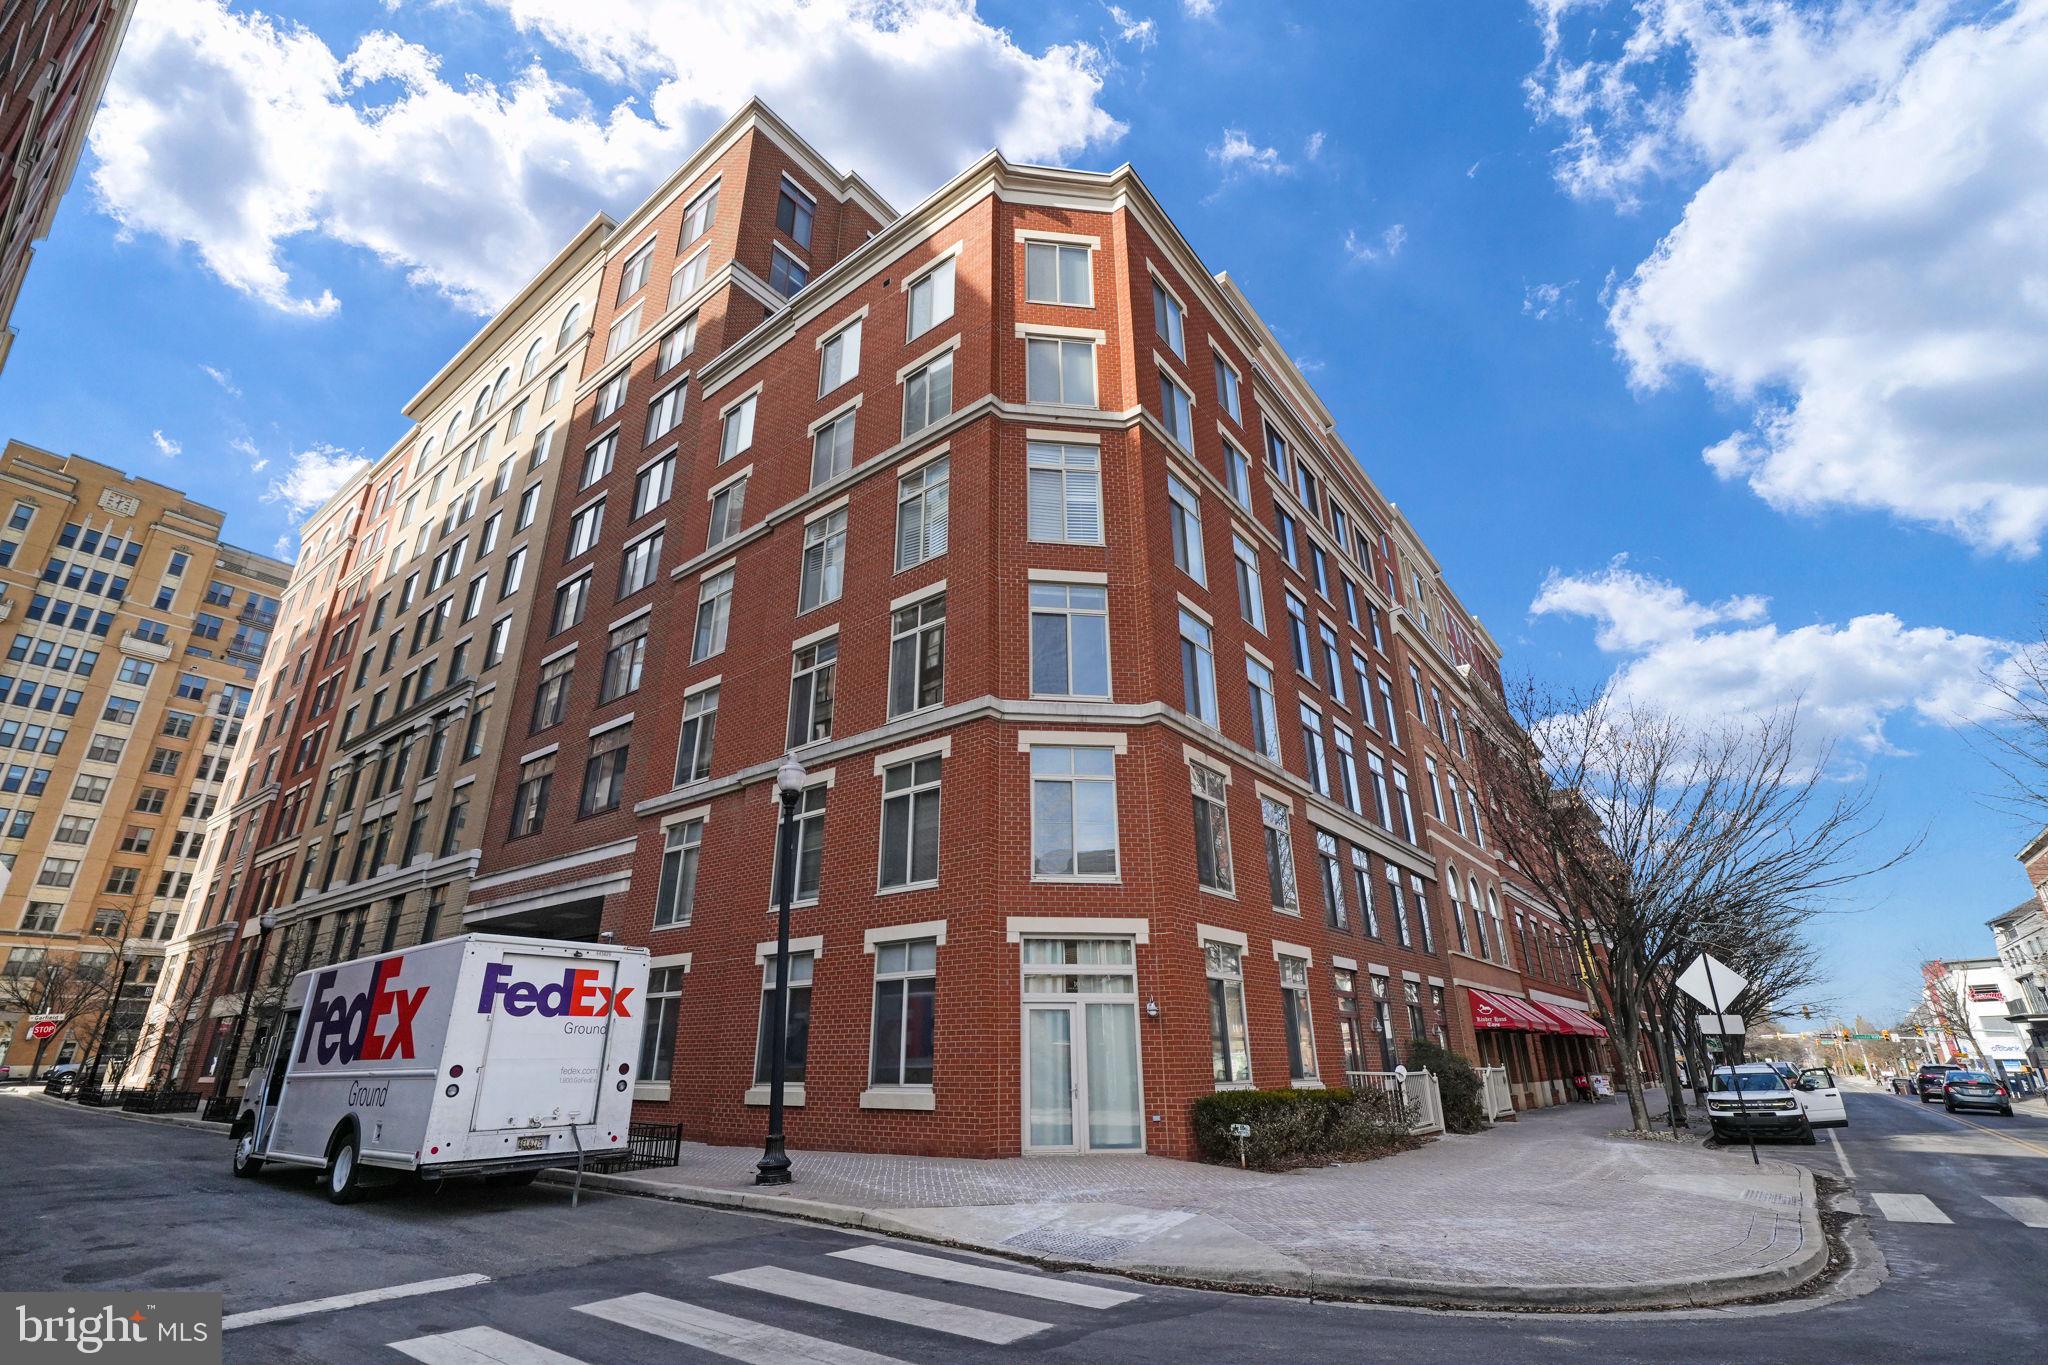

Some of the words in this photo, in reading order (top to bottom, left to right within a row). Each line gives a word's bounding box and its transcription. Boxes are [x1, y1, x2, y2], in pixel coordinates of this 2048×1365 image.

[477, 962, 635, 1018] FedEx
[298, 956, 431, 1065] FedEx
[564, 1021, 609, 1035] Ground
[560, 1066, 598, 1075] fedex.com
[348, 1079, 390, 1107] Ground
